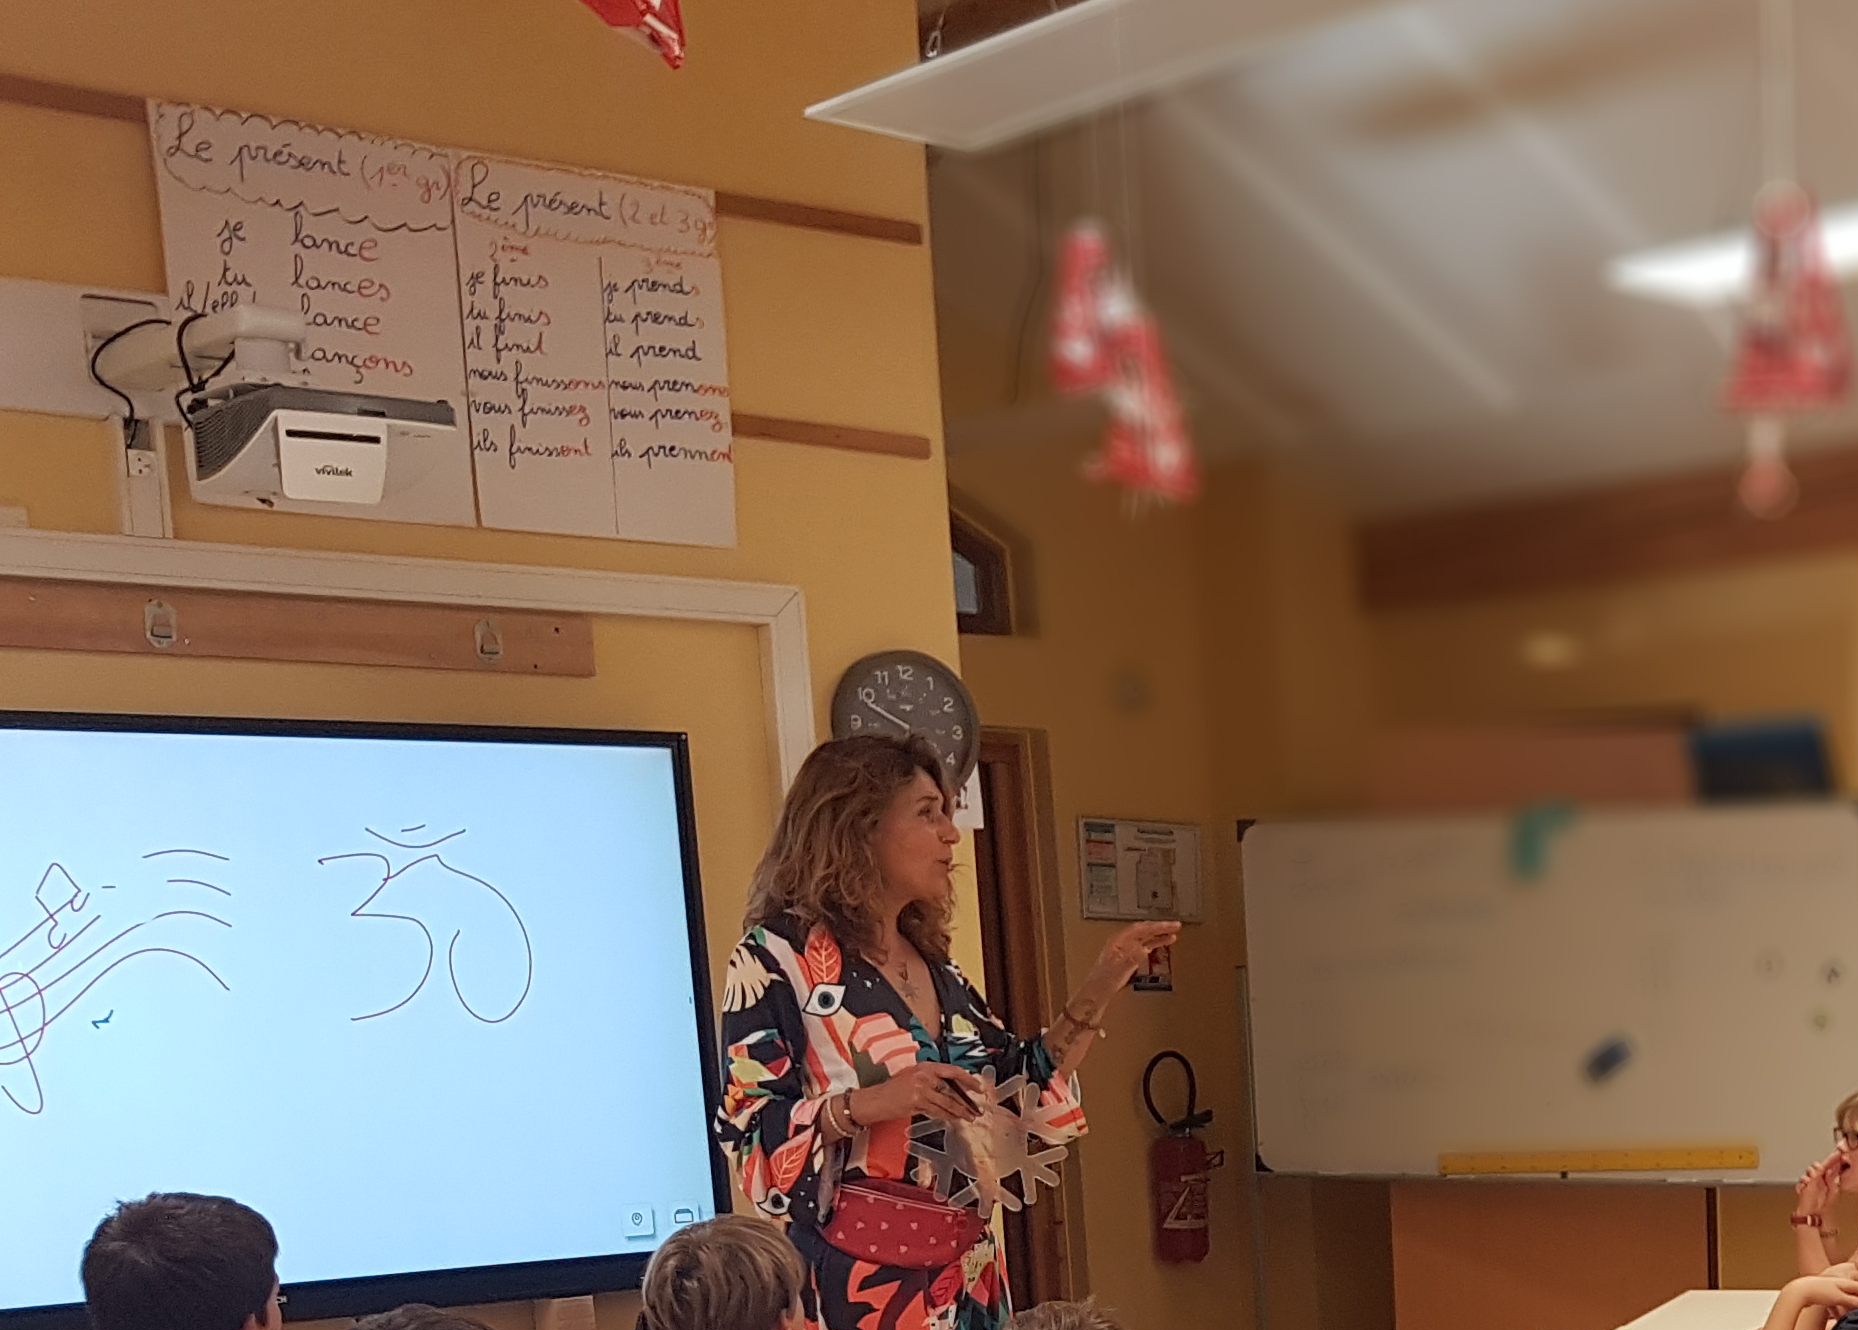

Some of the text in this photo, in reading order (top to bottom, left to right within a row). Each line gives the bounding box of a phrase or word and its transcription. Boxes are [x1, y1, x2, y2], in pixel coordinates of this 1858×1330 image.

[166, 110, 213, 163] Le
[230, 143, 350, 183] présent
[461, 161, 501, 211] Le
[512, 190, 611, 230] présent
[216, 211, 379, 262] je lance
[217, 254, 391, 302] tu lances
[465, 264, 549, 299] je finis
[466, 297, 551, 336] tu finis
[605, 306, 625, 323] tu
[467, 325, 482, 351] il
[606, 333, 702, 368] il prend
[469, 367, 508, 382] nous
[609, 379, 645, 392] nous
[470, 387, 591, 429] vous finissez
[610, 407, 723, 432] vous prenez
[473, 428, 498, 452] ils
[611, 437, 632, 459] ils
[874, 671, 889, 686] 11
[897, 664, 914, 681] 12
[926, 676, 934, 691] 1
[857, 687, 876, 703] 10
[943, 697, 954, 712] 2
[850, 714, 862, 730] 9
[952, 725, 963, 740] 3
[946, 752, 956, 766] 4
